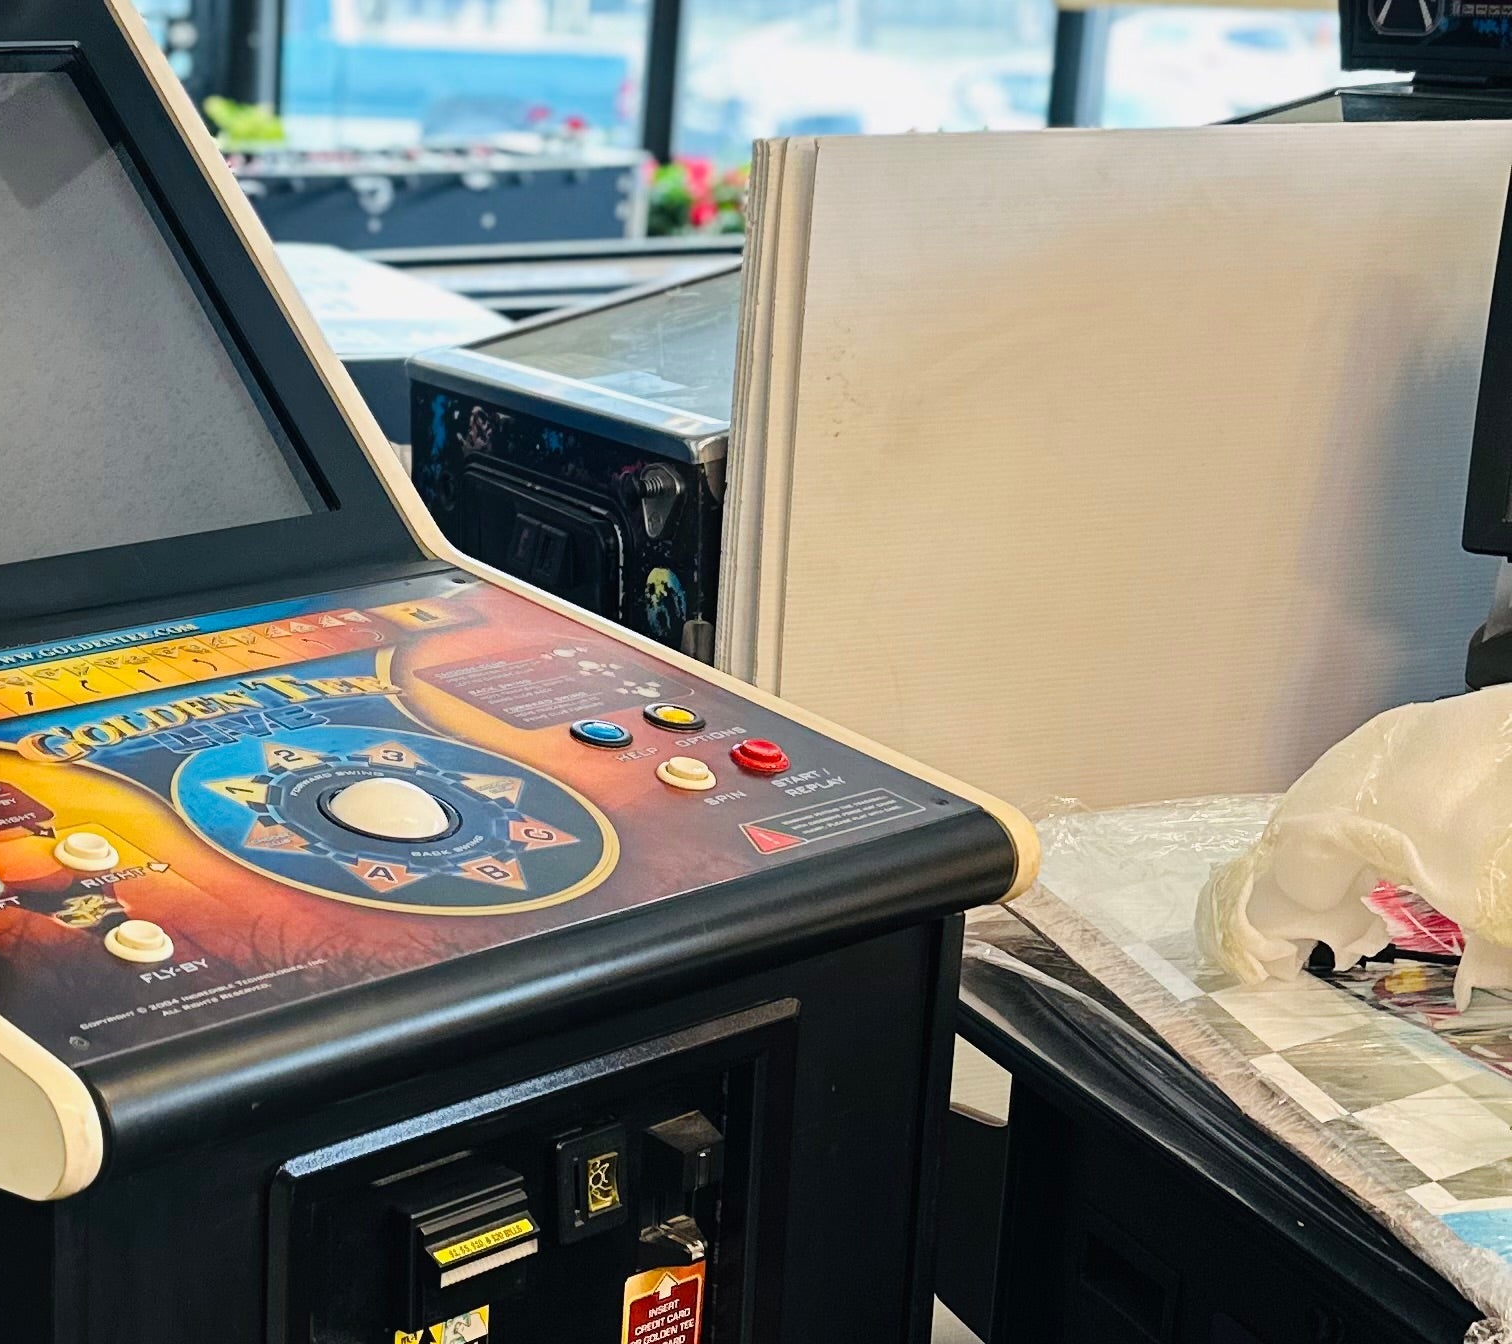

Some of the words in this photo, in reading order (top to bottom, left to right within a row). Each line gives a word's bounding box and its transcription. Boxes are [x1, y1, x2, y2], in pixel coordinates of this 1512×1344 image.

[16, 689, 266, 763] GOLDEN
[238, 674, 405, 705] TEE
[149, 705, 330, 754] LIVE
[675, 725, 748, 749] OPTIONS
[273, 748, 303, 763] 2
[381, 749, 404, 763] 3
[615, 747, 659, 764] HELP
[289, 771, 333, 797] FORWARD
[334, 770, 385, 778] SWING
[770, 769, 820, 790] START
[784, 774, 848, 799] REPLAY
[224, 785, 255, 795] 1
[703, 789, 748, 807] SPIN
[523, 828, 554, 841] C
[80, 866, 148, 890] RIGHT
[366, 866, 395, 883] A
[475, 864, 511, 881] B
[139, 957, 211, 985] FLY-BY
[648, 1299, 680, 1319] INSERT
[634, 1316, 666, 1336] CREDIT
[666, 1307, 691, 1324] CARD
[679, 1317, 695, 1332] TEE
